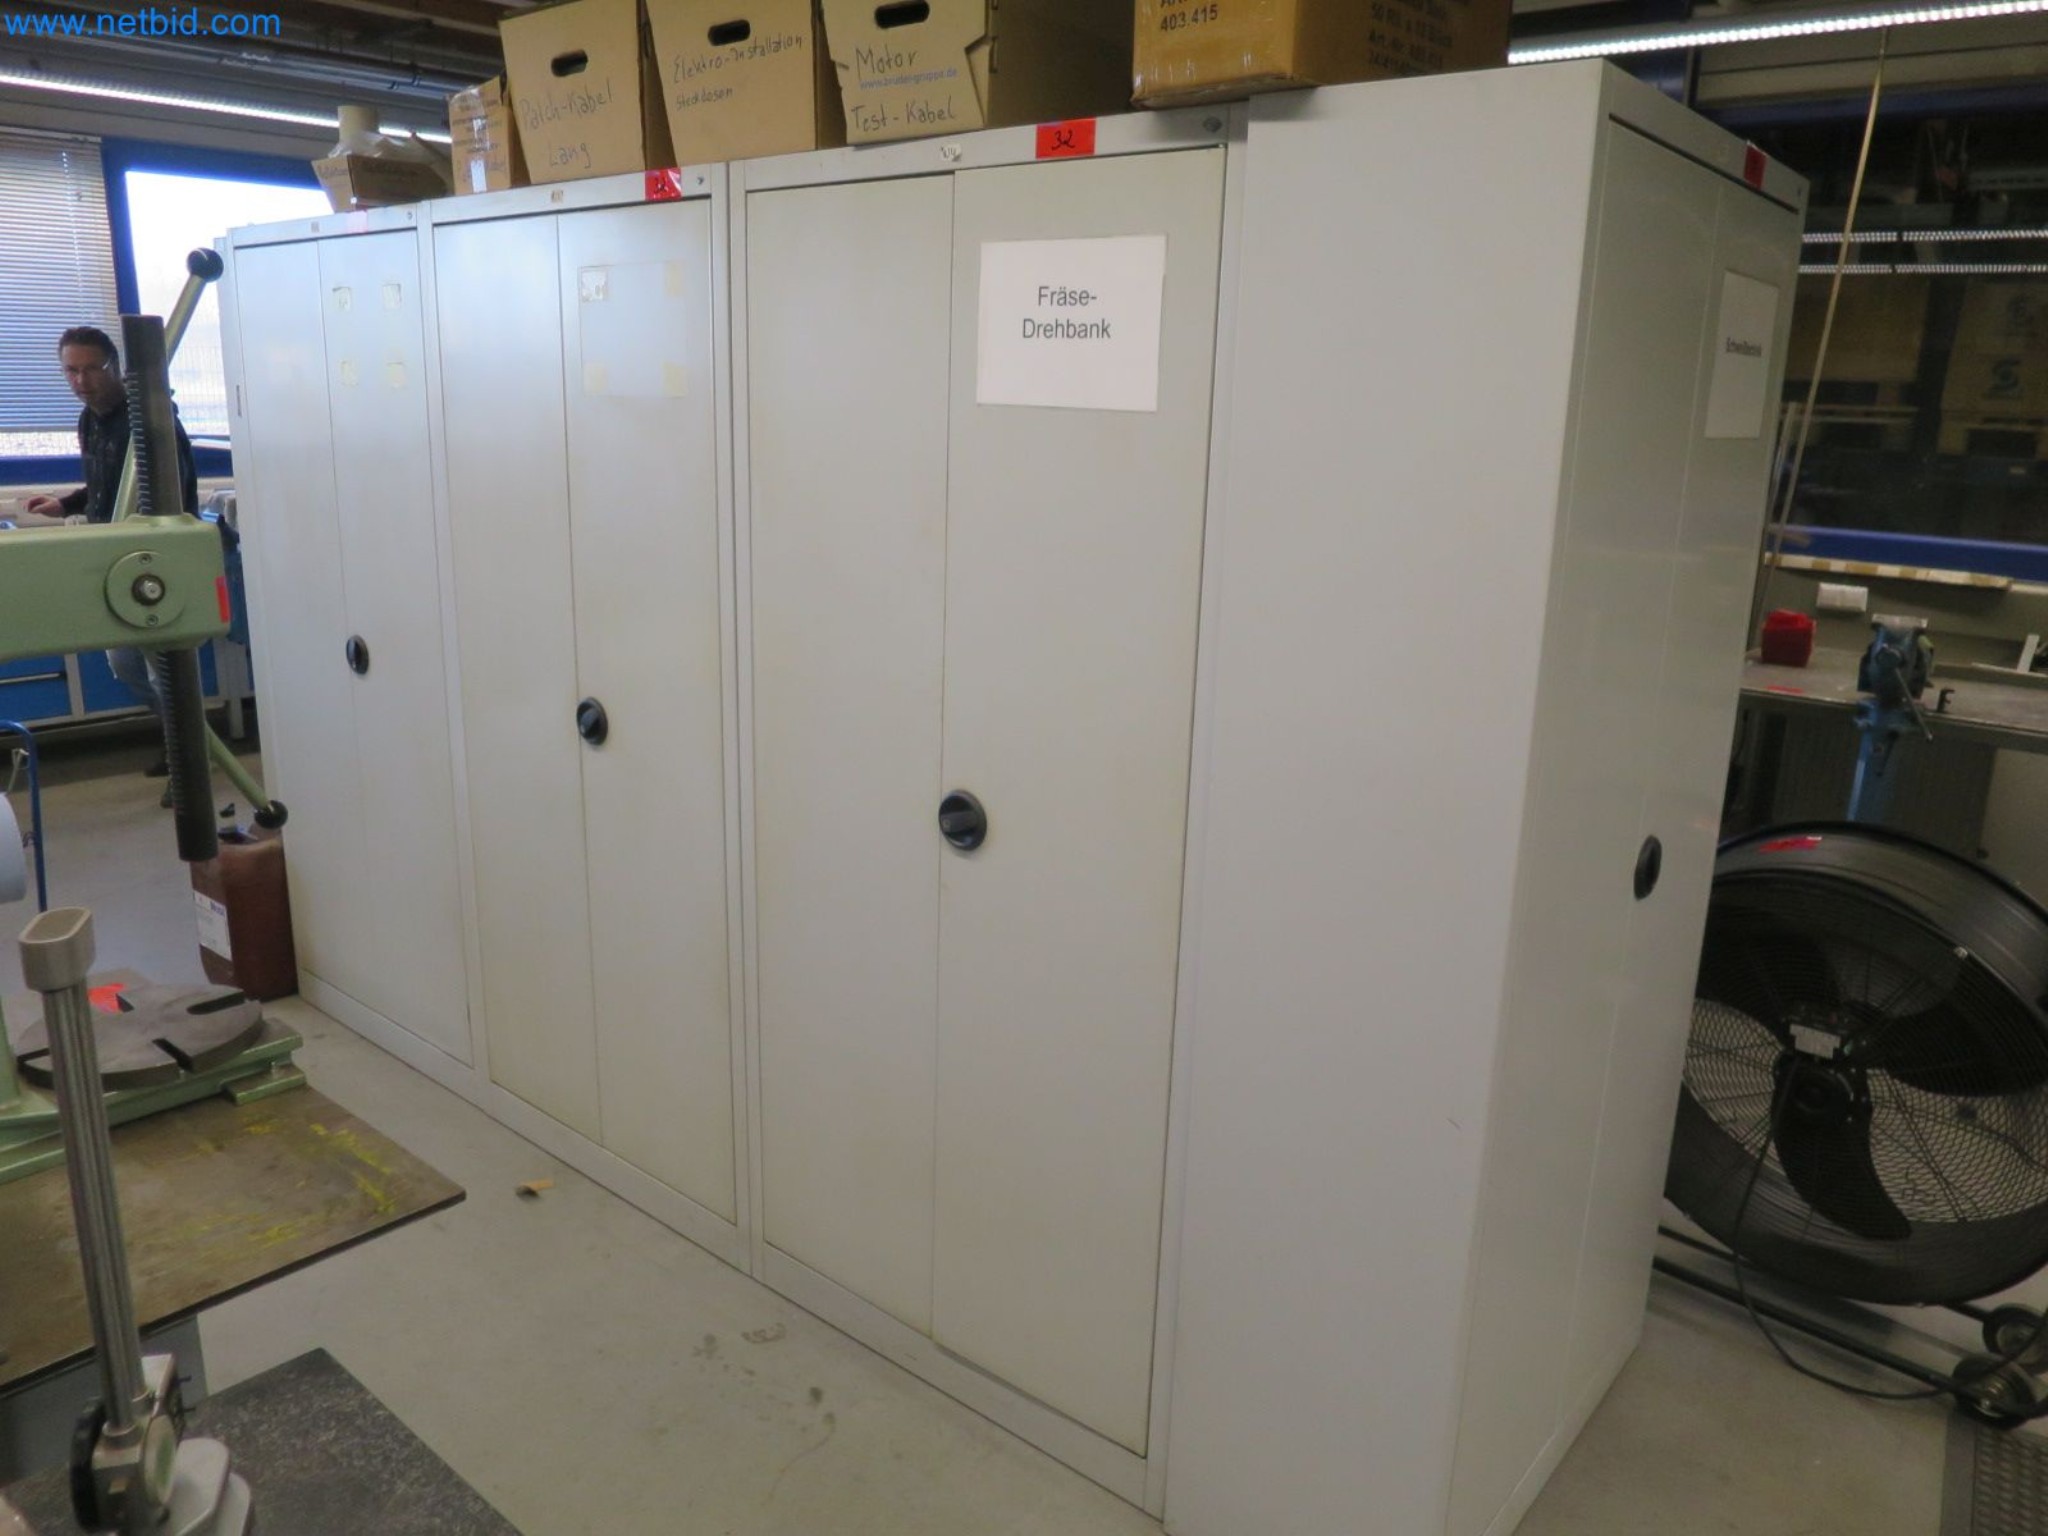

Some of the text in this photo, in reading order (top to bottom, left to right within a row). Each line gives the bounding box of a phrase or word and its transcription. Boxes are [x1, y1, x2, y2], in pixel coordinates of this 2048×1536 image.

[1160, 4, 1218, 31] 403.415
[855, 44, 918, 81] Motor
[520, 78, 613, 131] Patch-Kabel
[1051, 128, 1076, 151] 32
[548, 141, 591, 169] Lang
[1038, 286, 1098, 306] Fräse-
[1022, 318, 1111, 339] Drehbank
